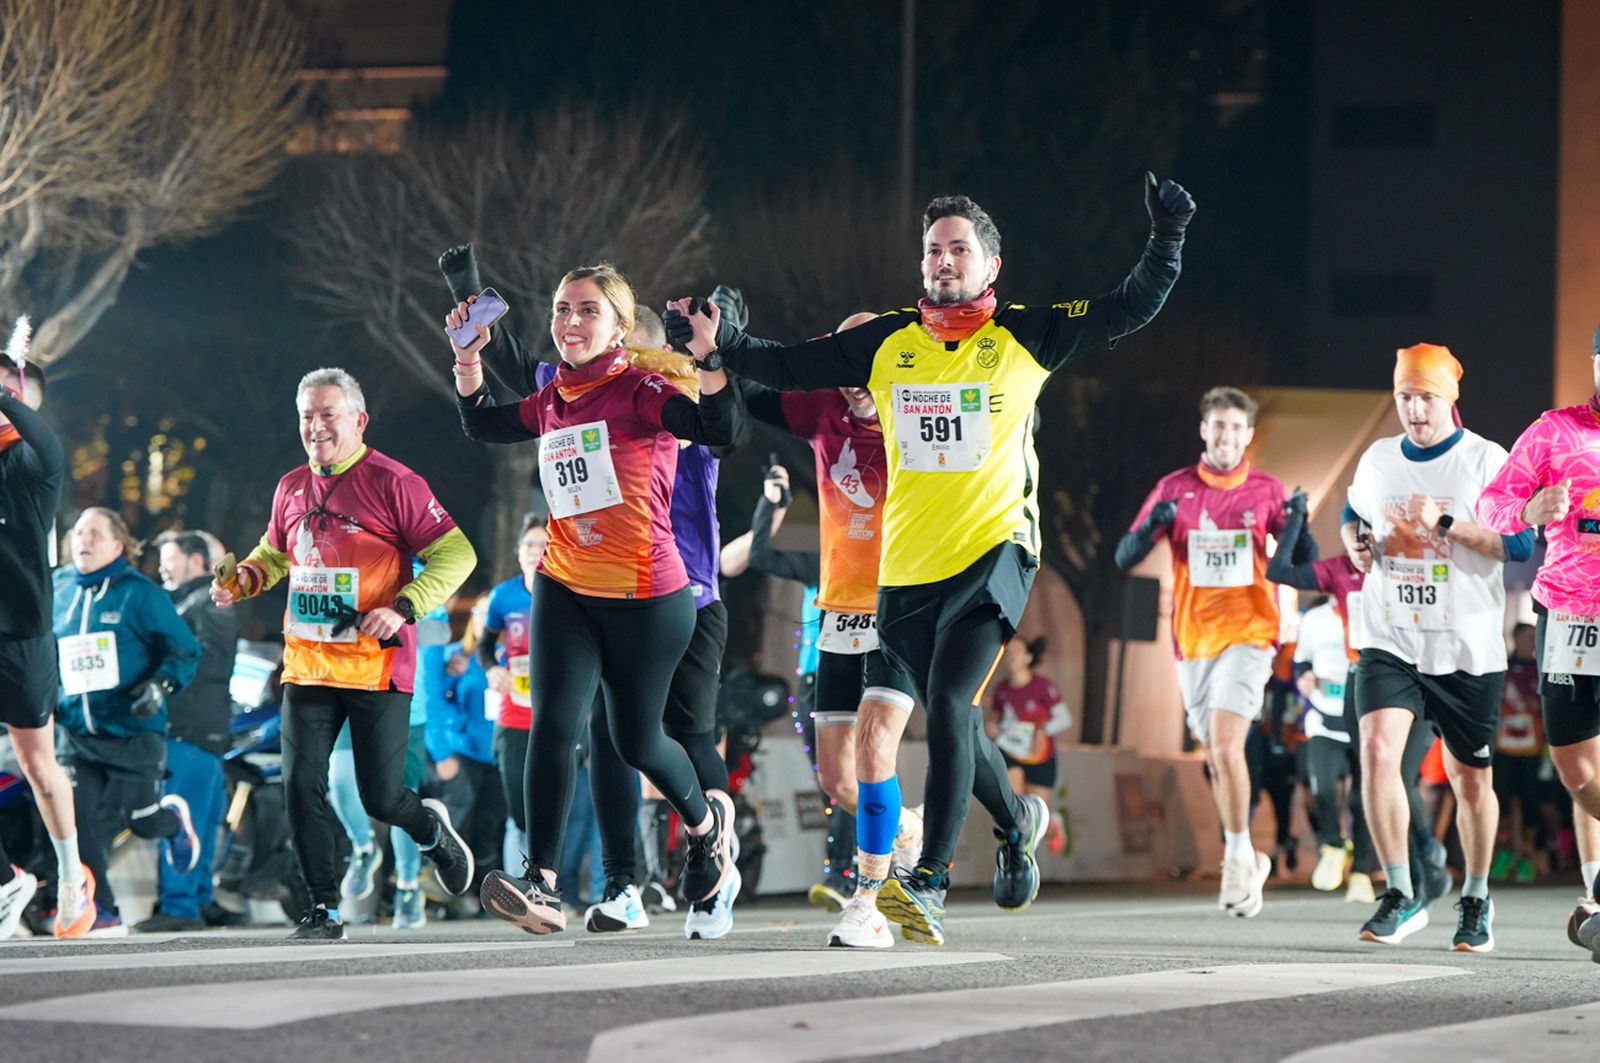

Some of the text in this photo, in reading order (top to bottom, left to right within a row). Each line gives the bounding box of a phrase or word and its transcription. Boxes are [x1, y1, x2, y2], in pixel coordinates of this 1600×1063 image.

[912, 394, 952, 404] NOCHE DE
[903, 405, 921, 415] SAN
[919, 416, 962, 443] 591
[555, 457, 589, 487] 319
[840, 474, 860, 495] 43
[1205, 551, 1237, 568] 7511
[1396, 584, 1437, 606] 1313
[1566, 624, 1599, 648] 776
